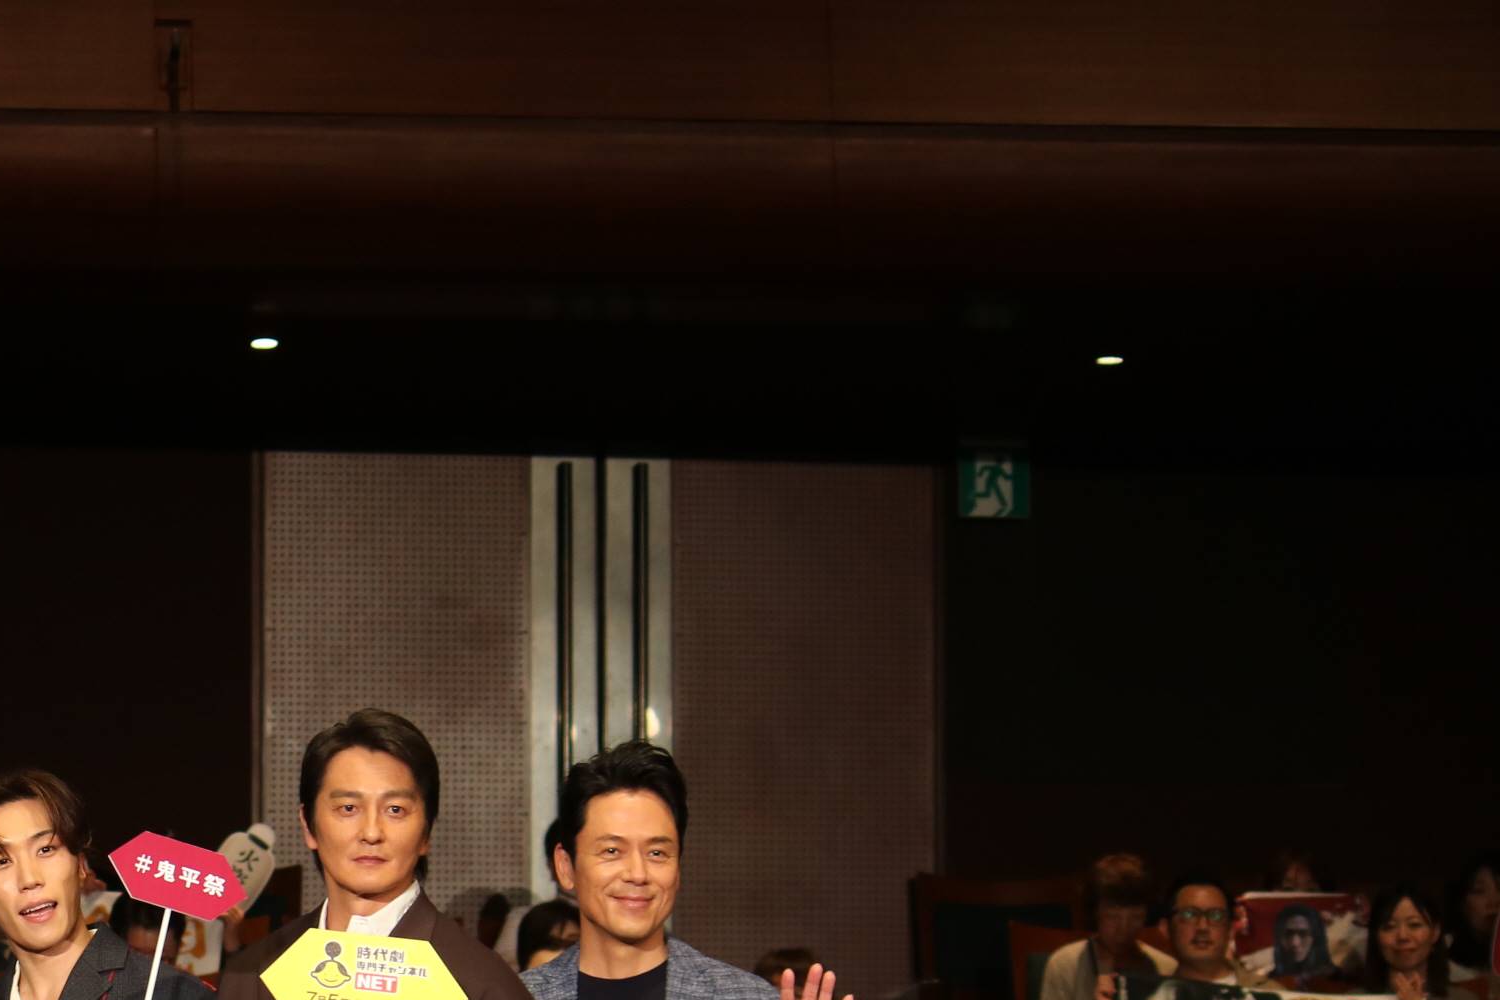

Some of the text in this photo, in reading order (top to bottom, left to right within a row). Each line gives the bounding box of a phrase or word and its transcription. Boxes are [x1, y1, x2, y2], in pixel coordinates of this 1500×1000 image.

[134, 854, 227, 900] #鬼平祭
[357, 946, 405, 964] 時代劇
[357, 973, 396, 993] NET
